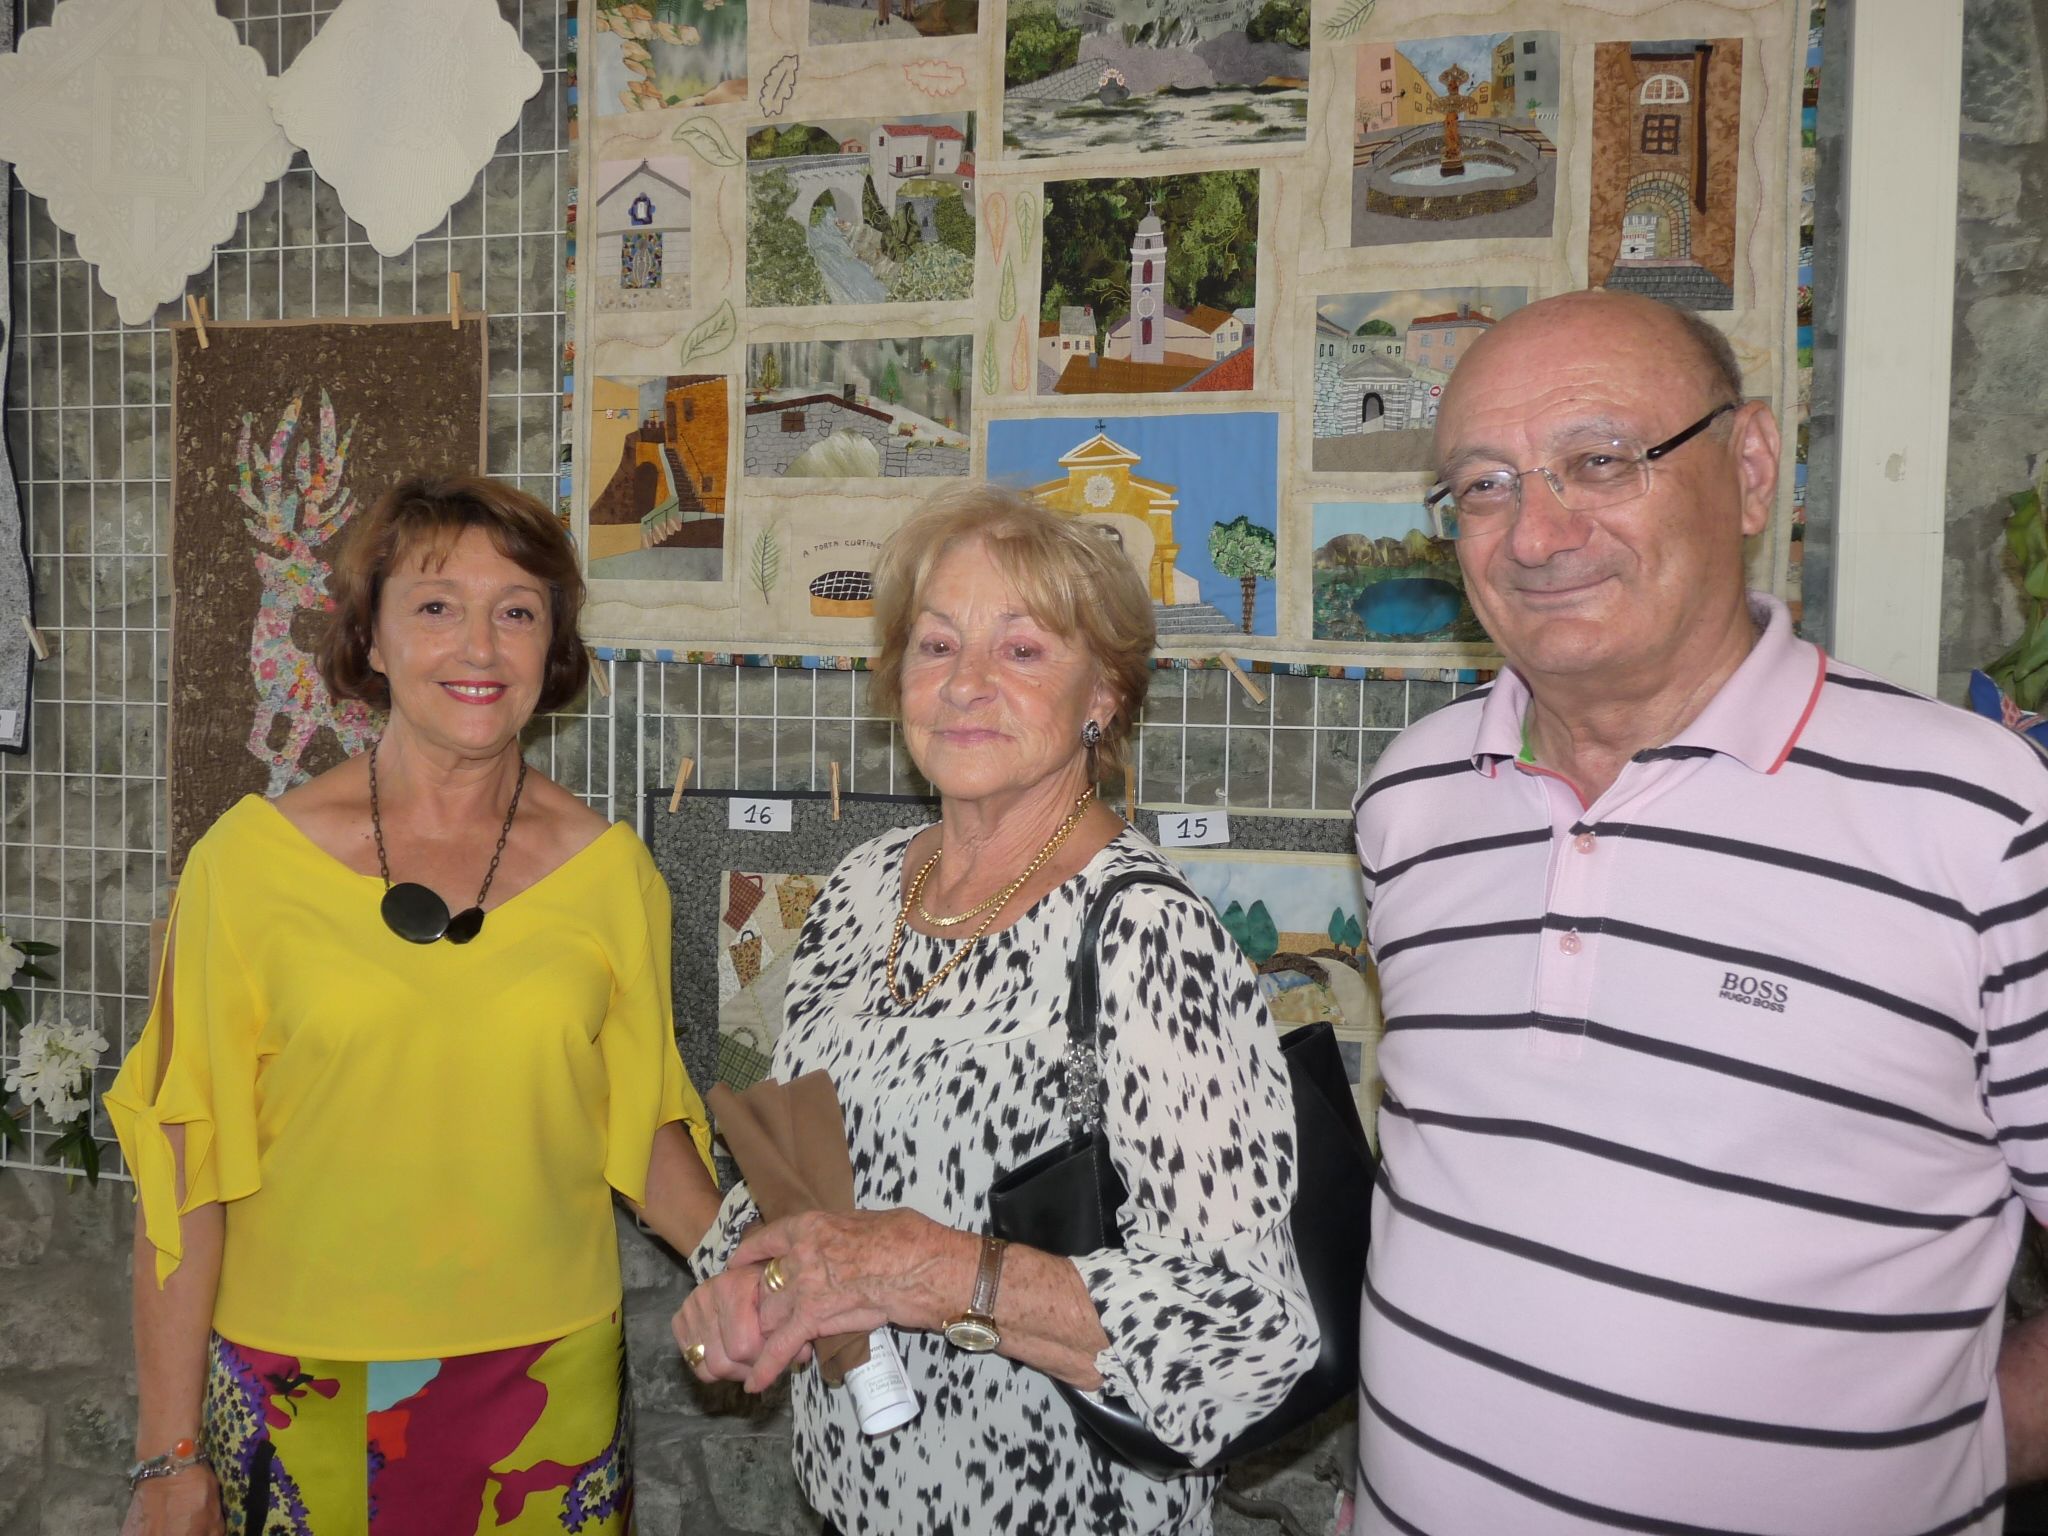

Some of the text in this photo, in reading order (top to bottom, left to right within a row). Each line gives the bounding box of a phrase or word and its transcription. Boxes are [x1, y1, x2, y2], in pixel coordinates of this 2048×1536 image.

[744, 804, 772, 825] 16
[1177, 818, 1208, 839] 15
[1721, 972, 1788, 1003] BOSS
[1719, 990, 1785, 1013] HUGO BOSS
